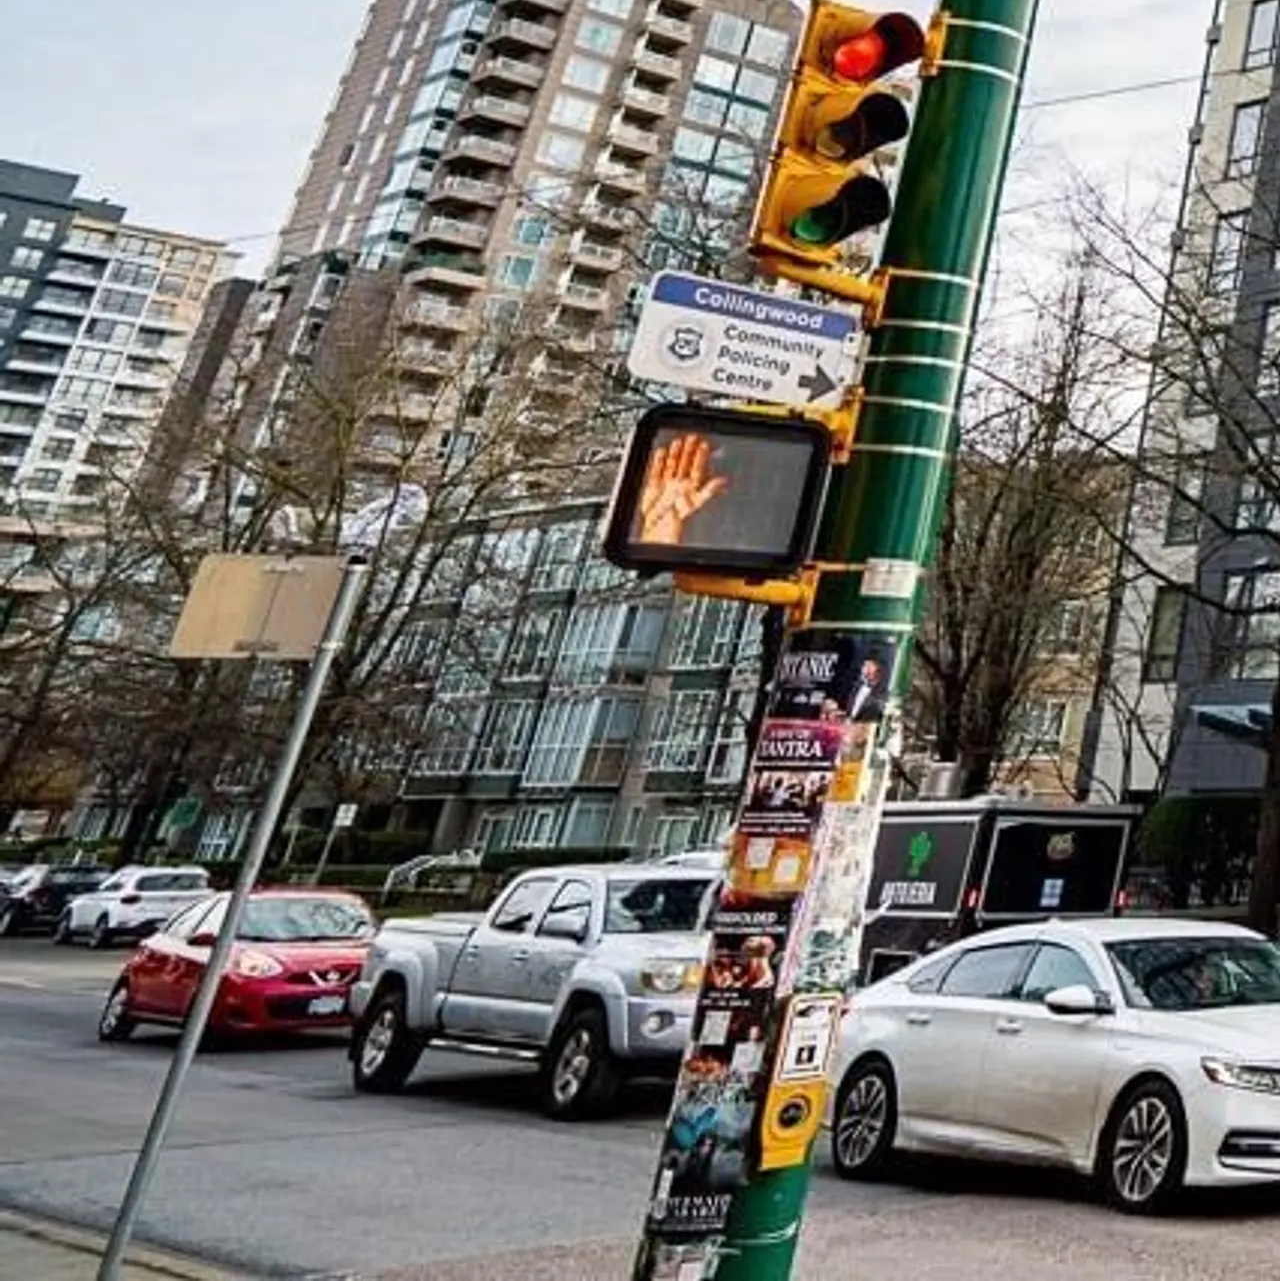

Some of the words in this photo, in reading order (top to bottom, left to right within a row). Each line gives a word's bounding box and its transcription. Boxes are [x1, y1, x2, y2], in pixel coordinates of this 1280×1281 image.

[694, 287, 823, 327] Collingwood
[723, 323, 826, 359] Community
[718, 345, 791, 375] Policing
[711, 367, 773, 392] Centre
